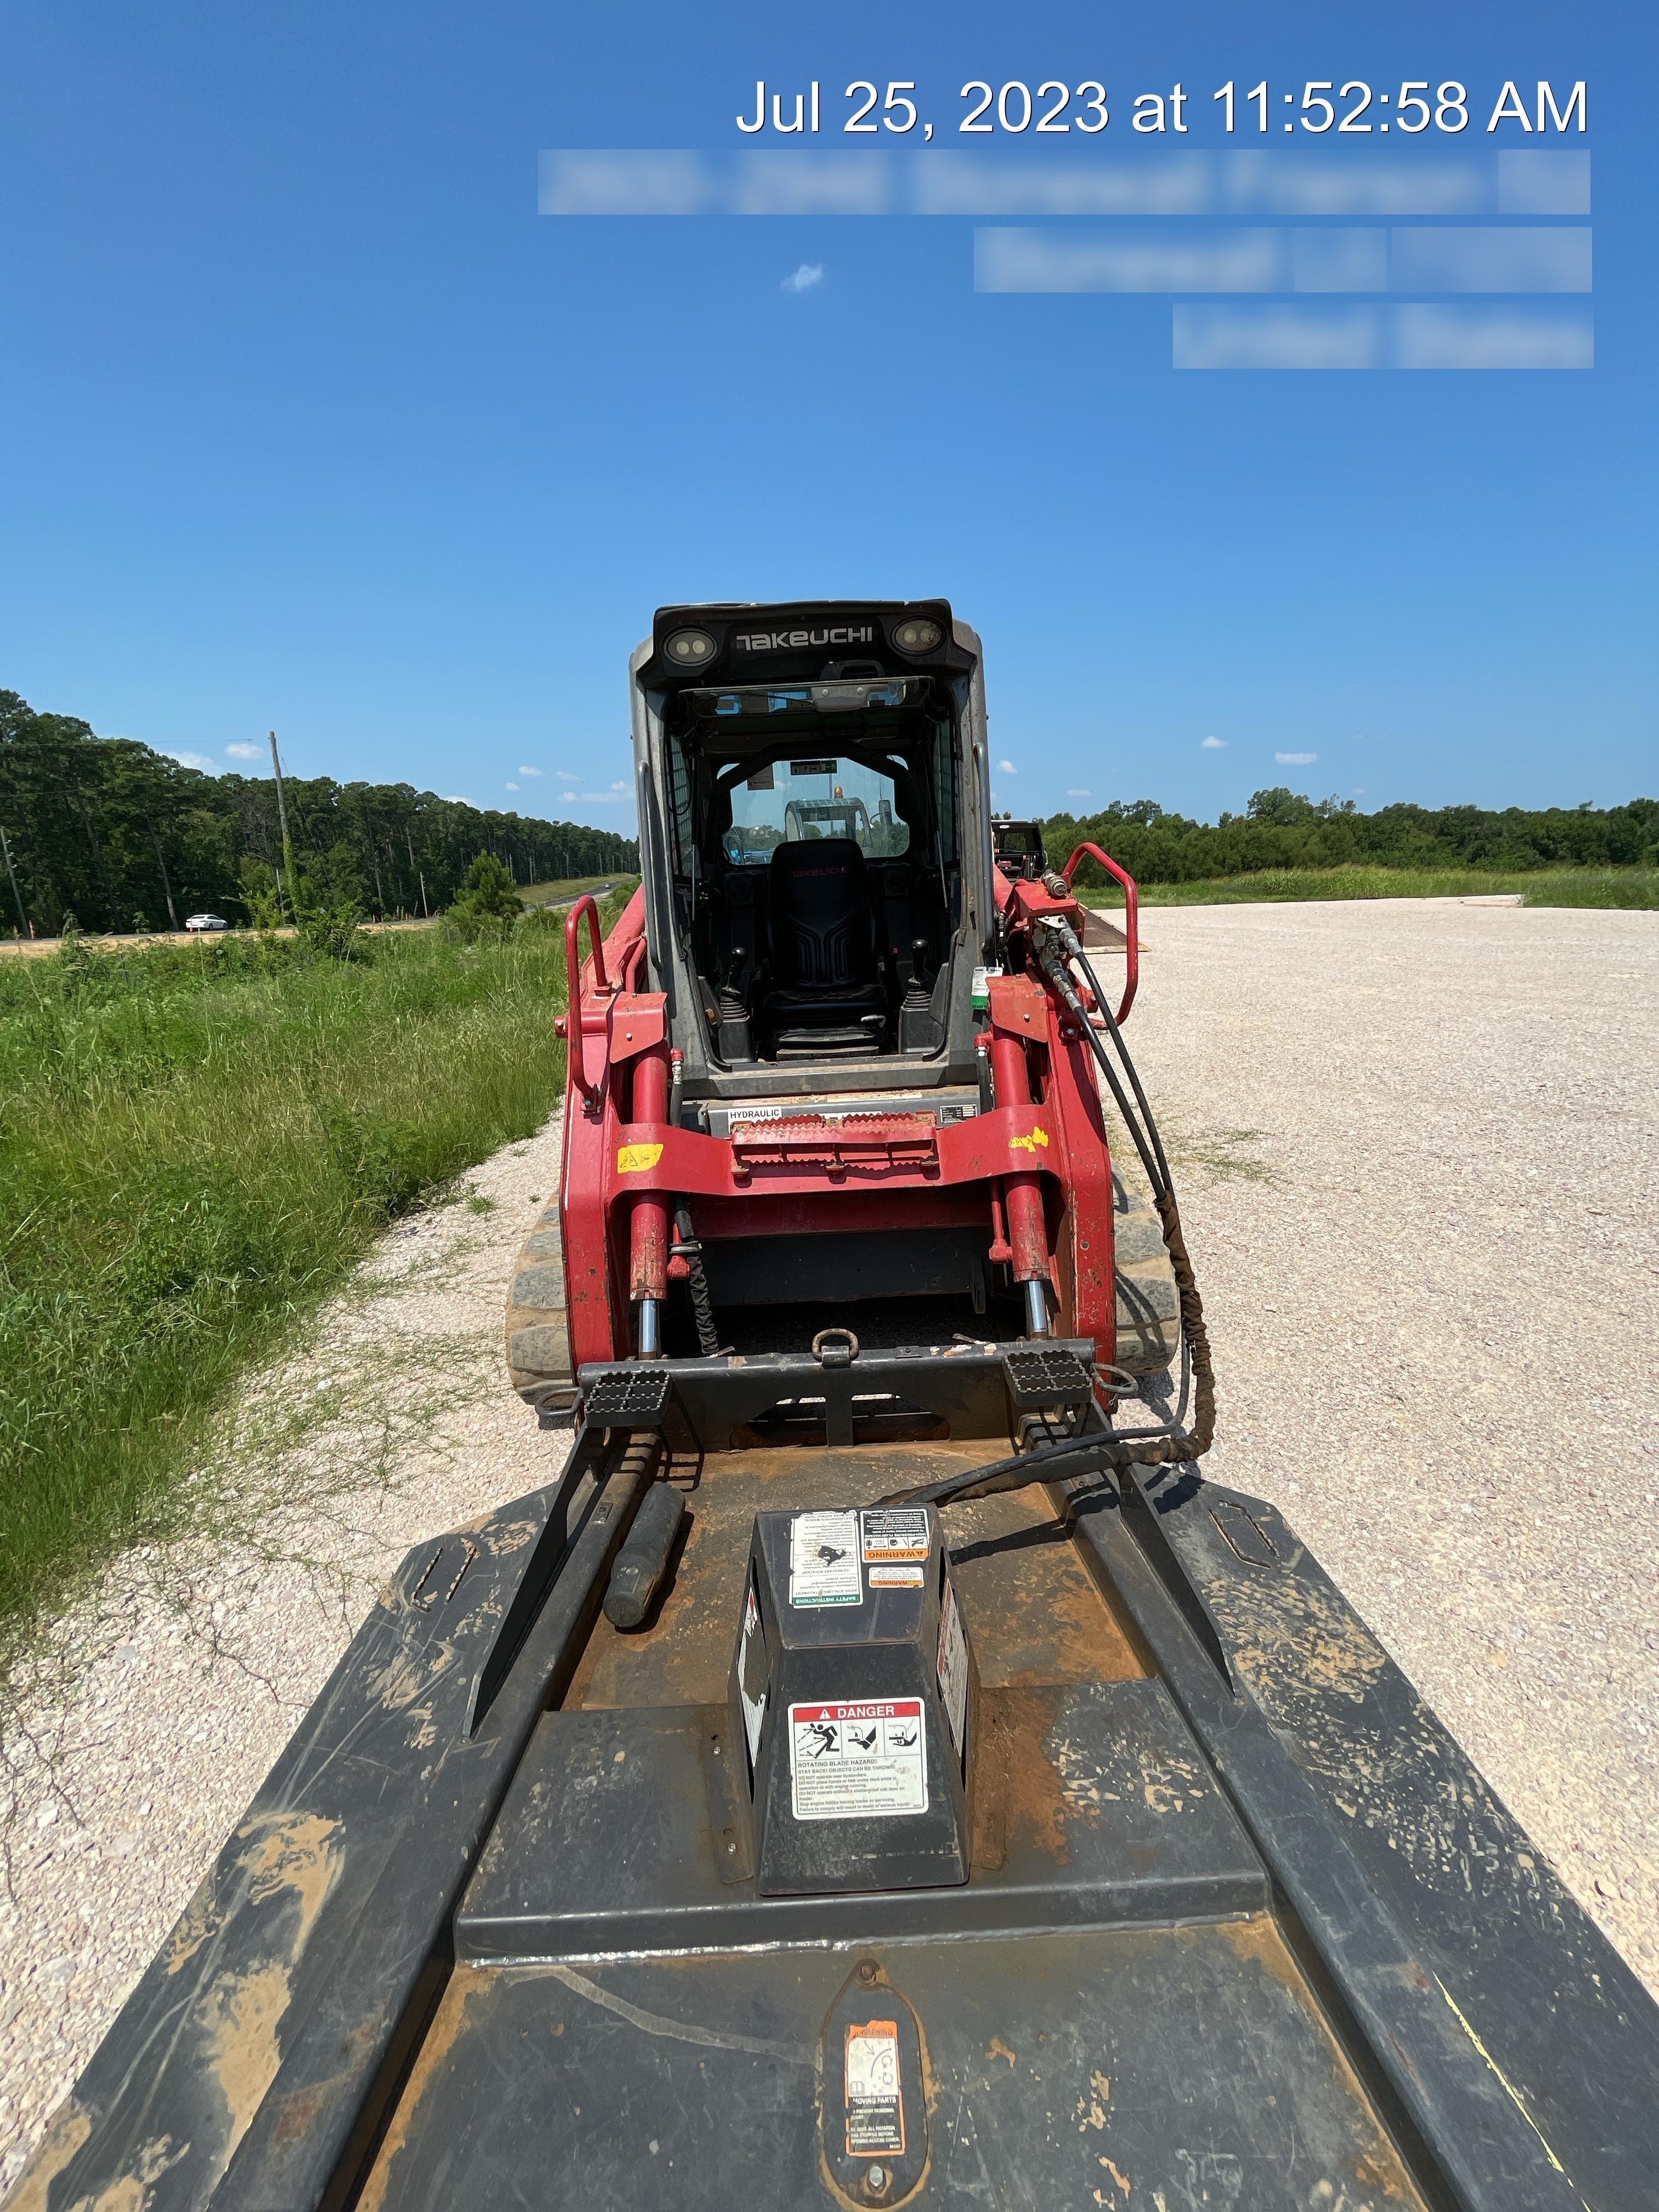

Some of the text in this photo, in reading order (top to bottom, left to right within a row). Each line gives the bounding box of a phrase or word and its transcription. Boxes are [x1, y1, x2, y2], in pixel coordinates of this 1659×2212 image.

[736, 627, 872, 651] TAKEUCHI
[789, 866, 847, 878] TAKEUCHI
[730, 1109, 780, 1119] HYDRAULIC
[837, 1706, 895, 1719] DANGER
[853, 2096, 897, 2106] MOVING PARTS
